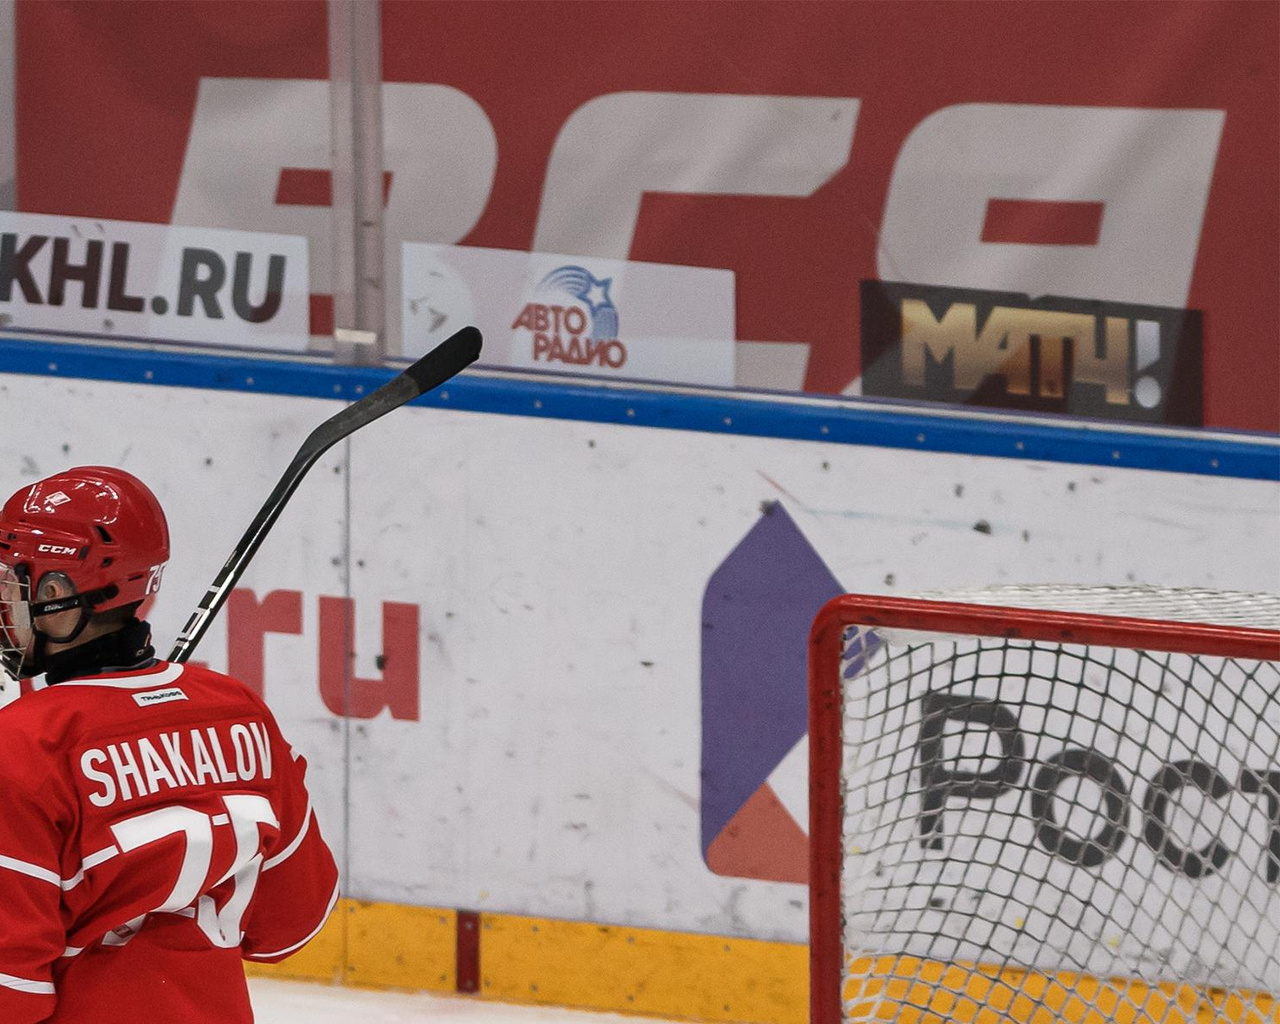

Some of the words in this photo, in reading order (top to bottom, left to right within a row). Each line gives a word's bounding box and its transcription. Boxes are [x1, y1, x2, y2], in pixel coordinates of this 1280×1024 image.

[511, 303, 587, 335] АВТО
[533, 333, 628, 368] РАДИО
[901, 299, 1162, 409] МАТЧ!
[38, 544, 77, 555] CCM
[145, 563, 167, 595] 75
[81, 722, 272, 808] SHAKALOV
[110, 794, 281, 949] 75
